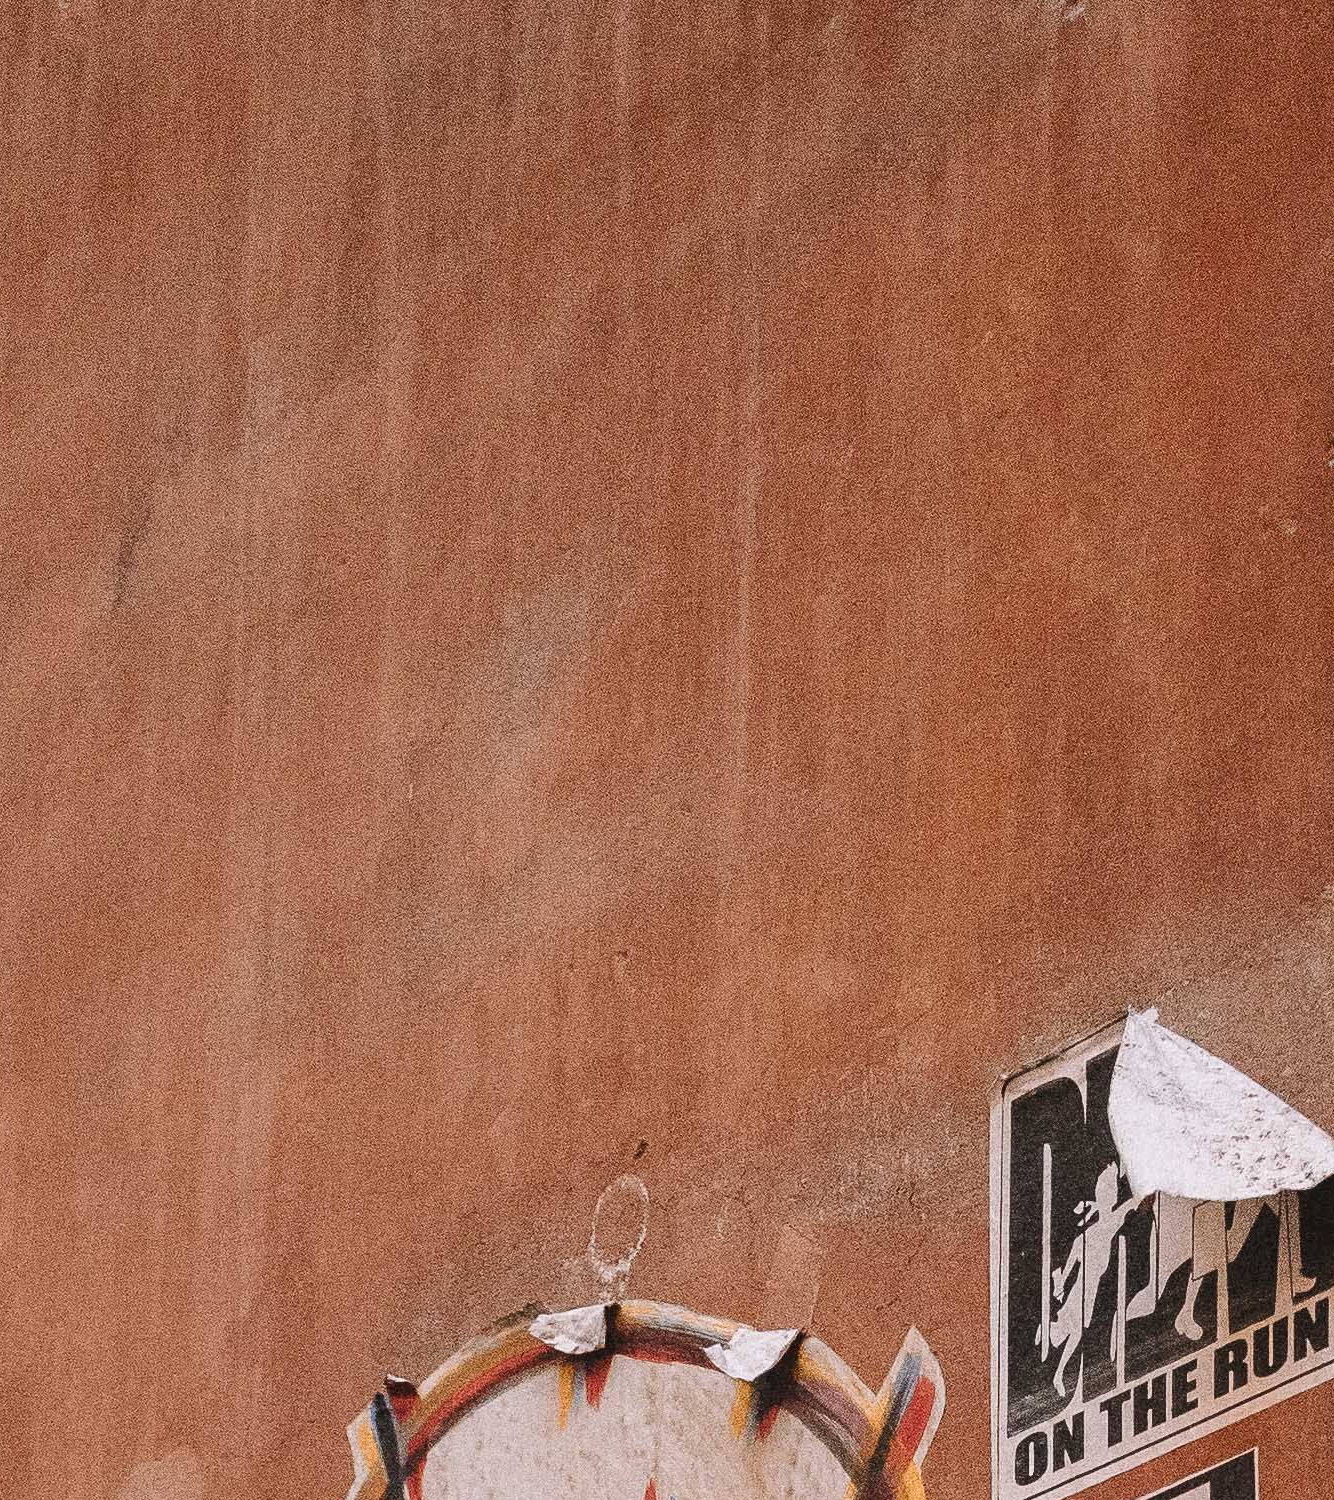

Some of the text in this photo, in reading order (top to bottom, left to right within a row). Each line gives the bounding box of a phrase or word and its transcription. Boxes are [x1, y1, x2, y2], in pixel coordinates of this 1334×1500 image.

[1014, 1298, 1330, 1486] ON THE RUN
